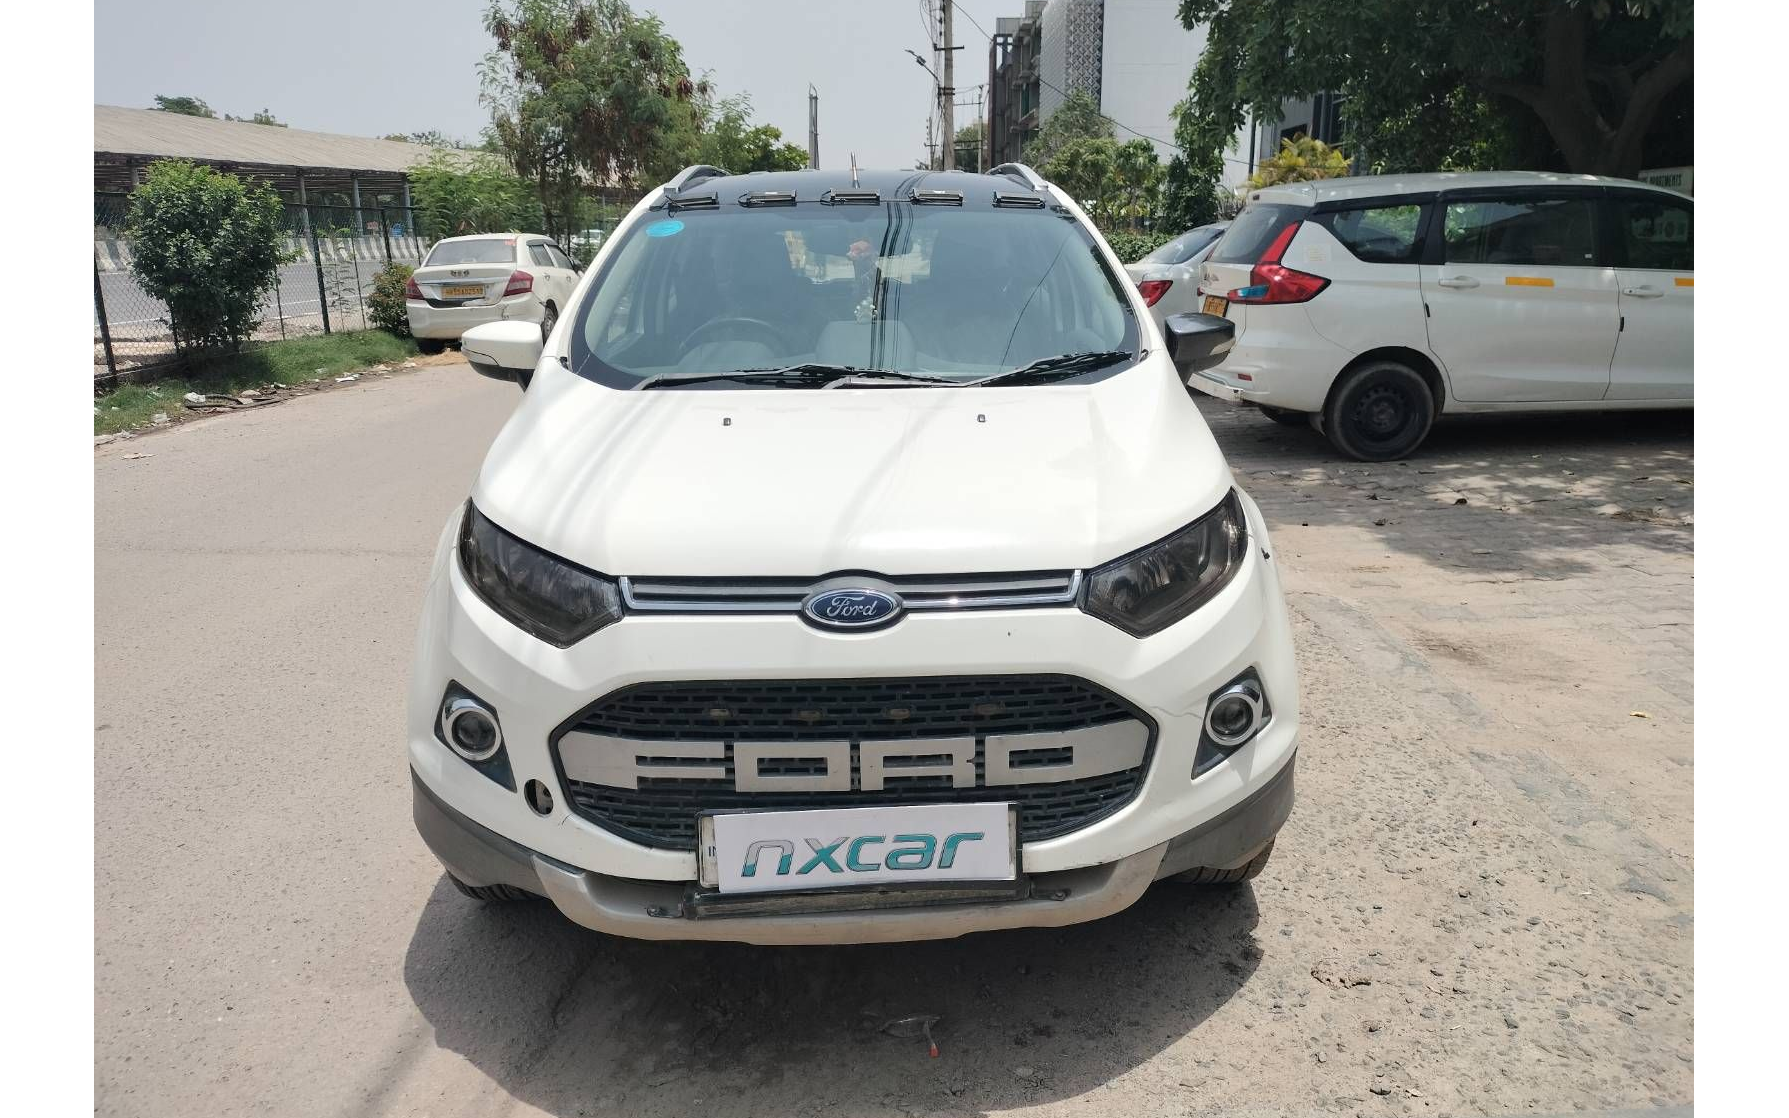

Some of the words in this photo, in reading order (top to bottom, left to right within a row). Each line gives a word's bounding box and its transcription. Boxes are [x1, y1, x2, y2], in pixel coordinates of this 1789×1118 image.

[826, 596, 877, 617] Ford
[557, 718, 1149, 792] FORD
[740, 831, 985, 878] nxcar
